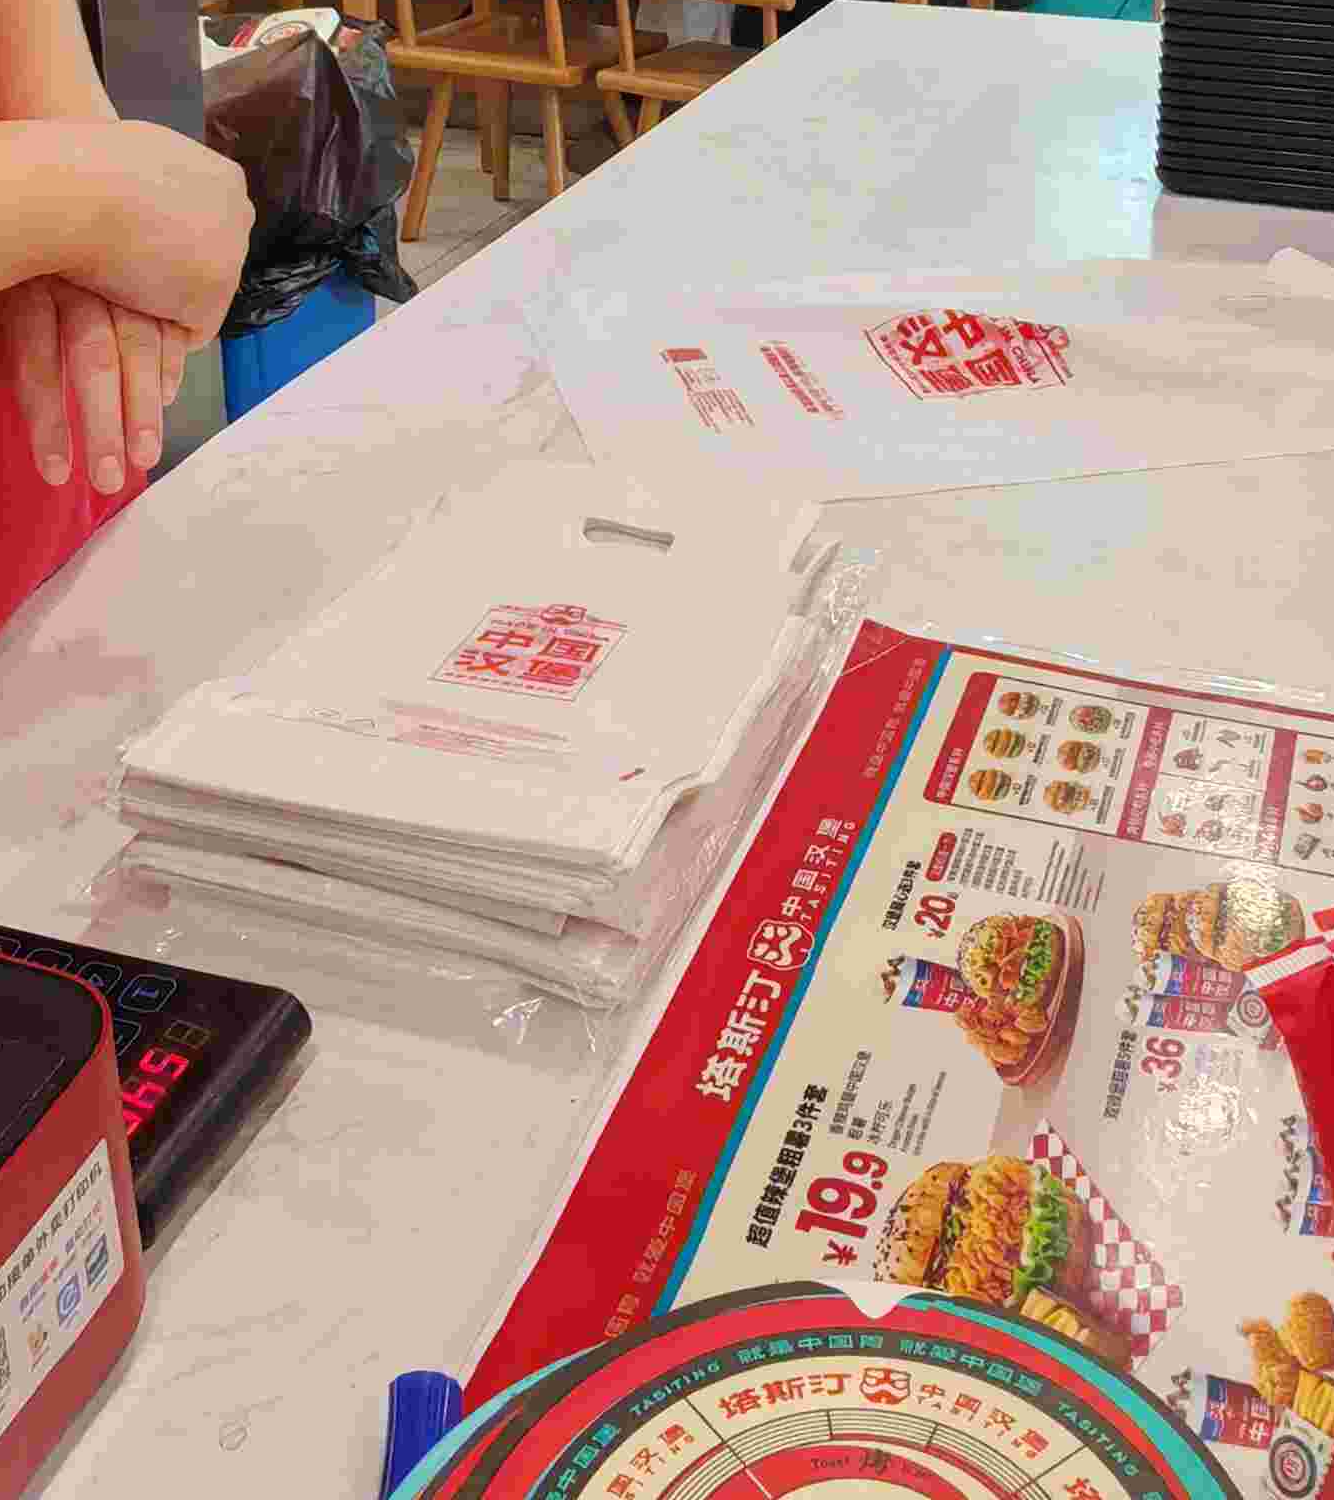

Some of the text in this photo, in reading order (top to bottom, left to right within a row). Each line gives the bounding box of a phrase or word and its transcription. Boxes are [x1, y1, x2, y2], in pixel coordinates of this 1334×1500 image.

[475, 630, 604, 663] 中国
[695, 815, 844, 1103] 塔斯汀 中国汉堡
[794, 1150, 889, 1267] ¥19.9
[717, 1372, 853, 1420] 塔斯汀
